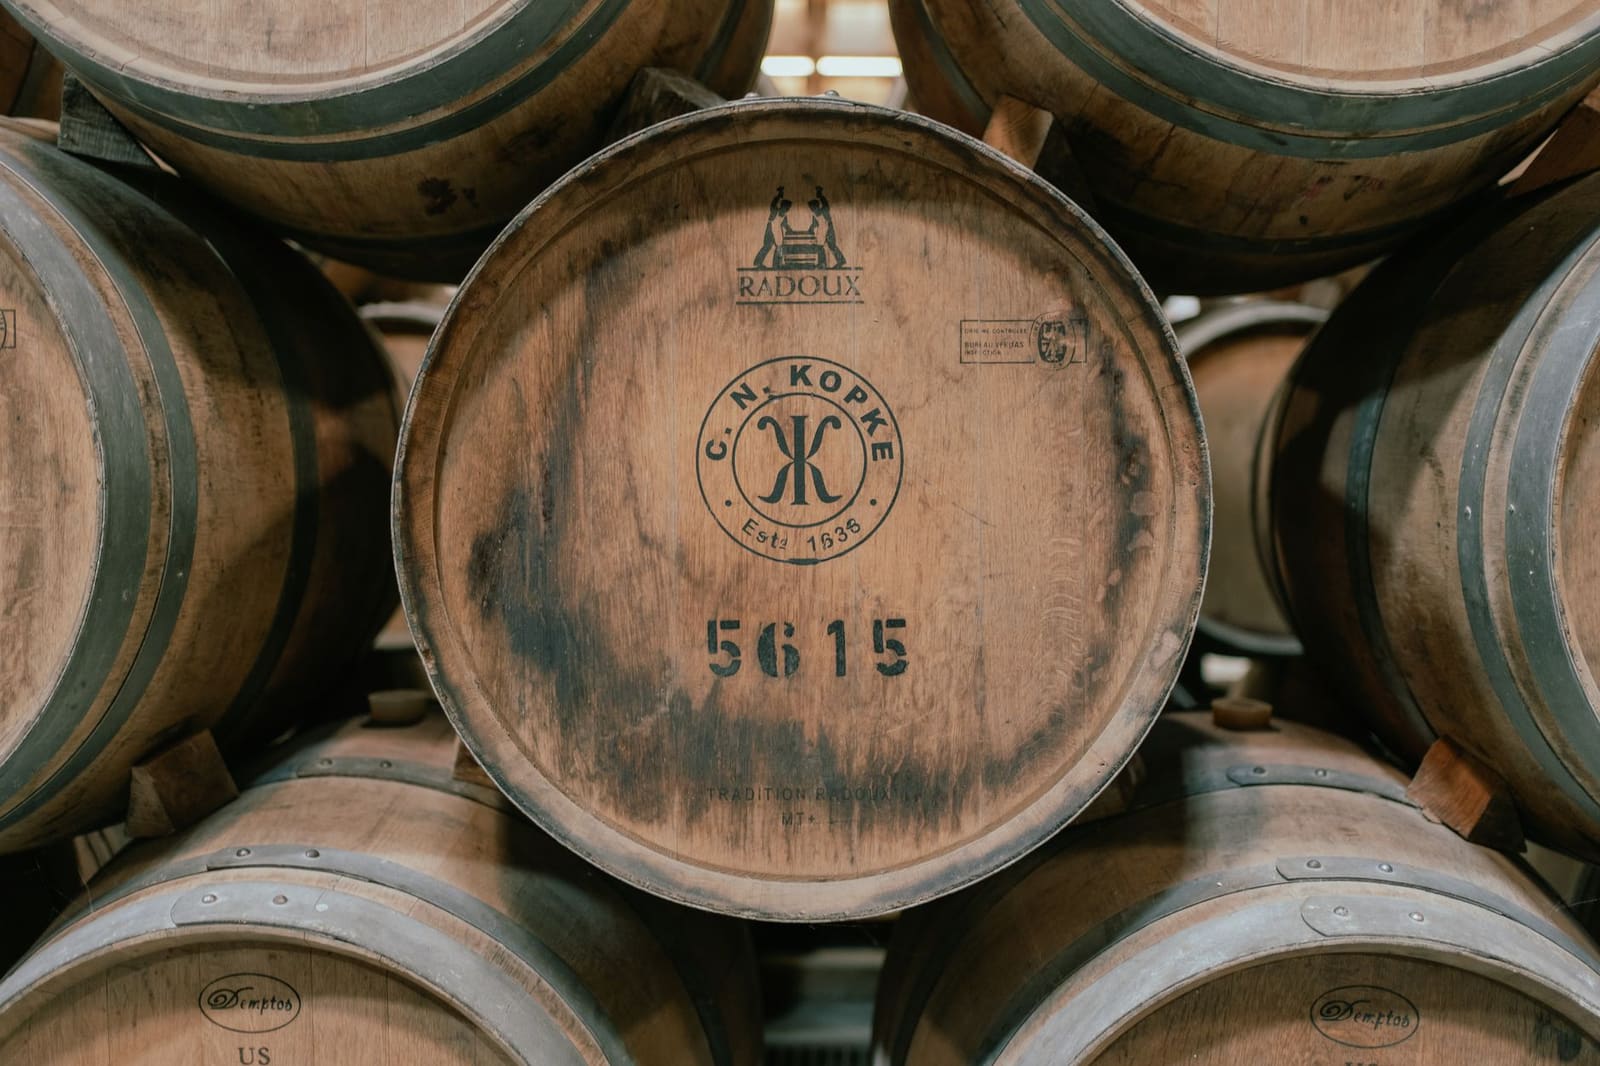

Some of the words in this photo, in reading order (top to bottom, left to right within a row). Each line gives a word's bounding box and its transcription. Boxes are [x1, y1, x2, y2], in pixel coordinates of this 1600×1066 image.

[739, 275, 861, 297] RADOUX
[705, 427, 732, 461] C.
[730, 382, 771, 411] N.
[789, 364, 894, 462] KOPKE
[707, 618, 910, 678] 5615
[706, 787, 806, 801] TRADITION
[207, 986, 293, 1015] Demptos
[1319, 1000, 1410, 1030] Demptos
[238, 1046, 271, 1066] US
